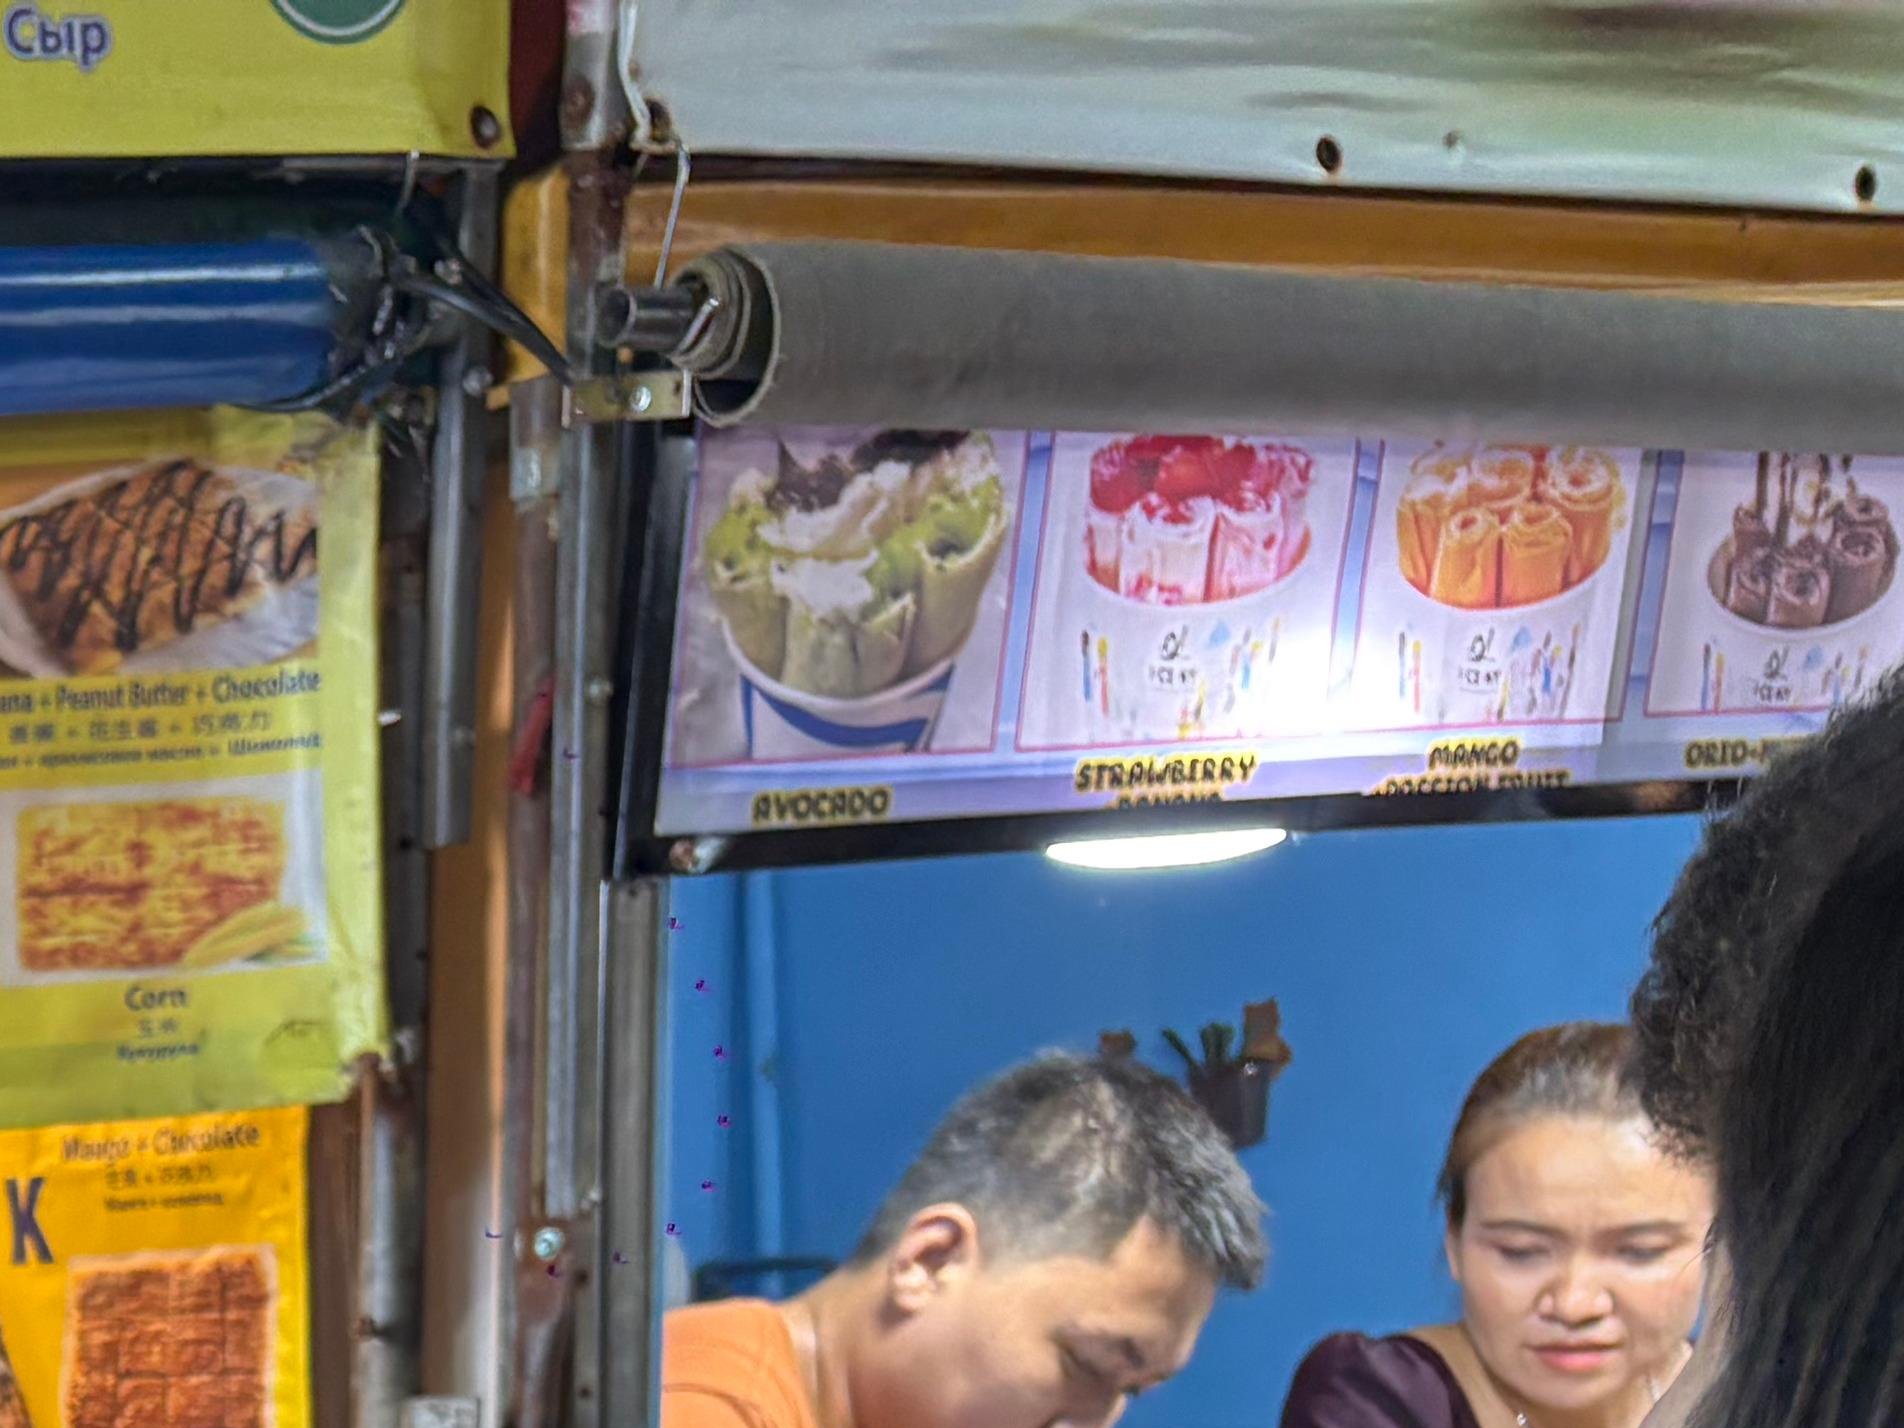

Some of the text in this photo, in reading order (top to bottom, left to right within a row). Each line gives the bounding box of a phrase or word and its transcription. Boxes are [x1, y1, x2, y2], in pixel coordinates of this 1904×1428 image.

[7, 9, 110, 67] Сыр
[1076, 755, 1256, 792] STRAWBERRY
[1427, 740, 1521, 770] MANGO
[752, 786, 890, 823] AVOCADO
[124, 985, 188, 1012] Corn
